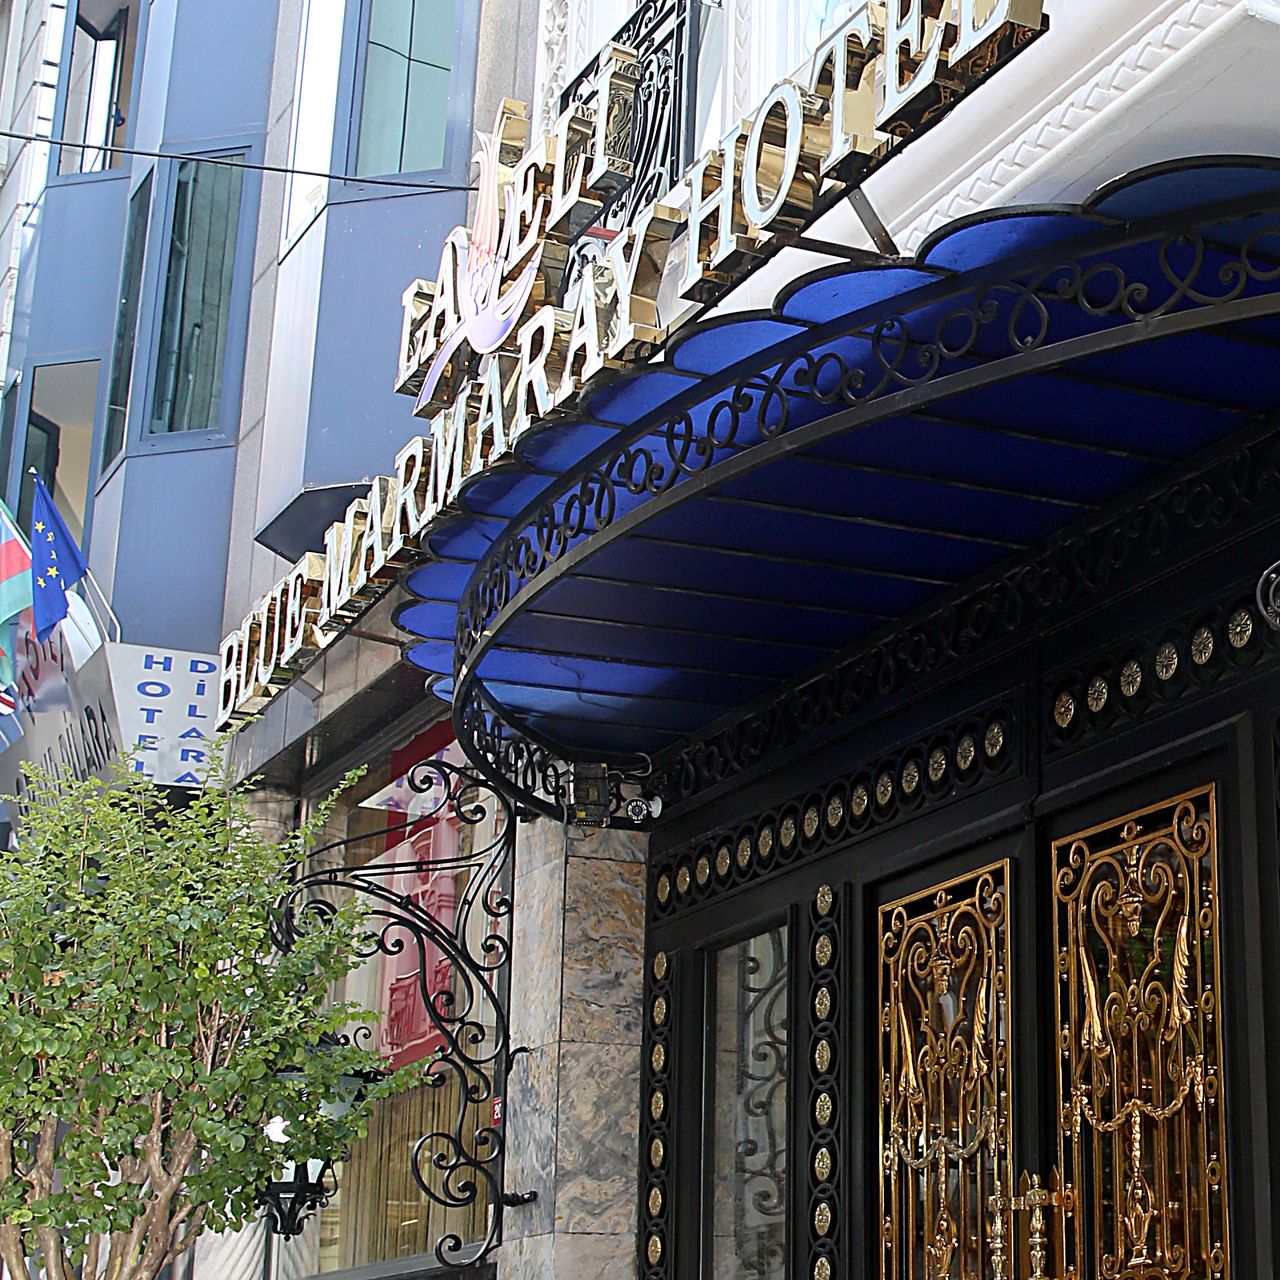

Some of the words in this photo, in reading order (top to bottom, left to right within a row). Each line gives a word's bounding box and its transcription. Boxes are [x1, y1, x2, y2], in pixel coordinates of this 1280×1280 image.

[214, 553, 325, 733] BLUE
[318, 204, 668, 628] MARMARAY
[134, 654, 173, 779] HOTEL
